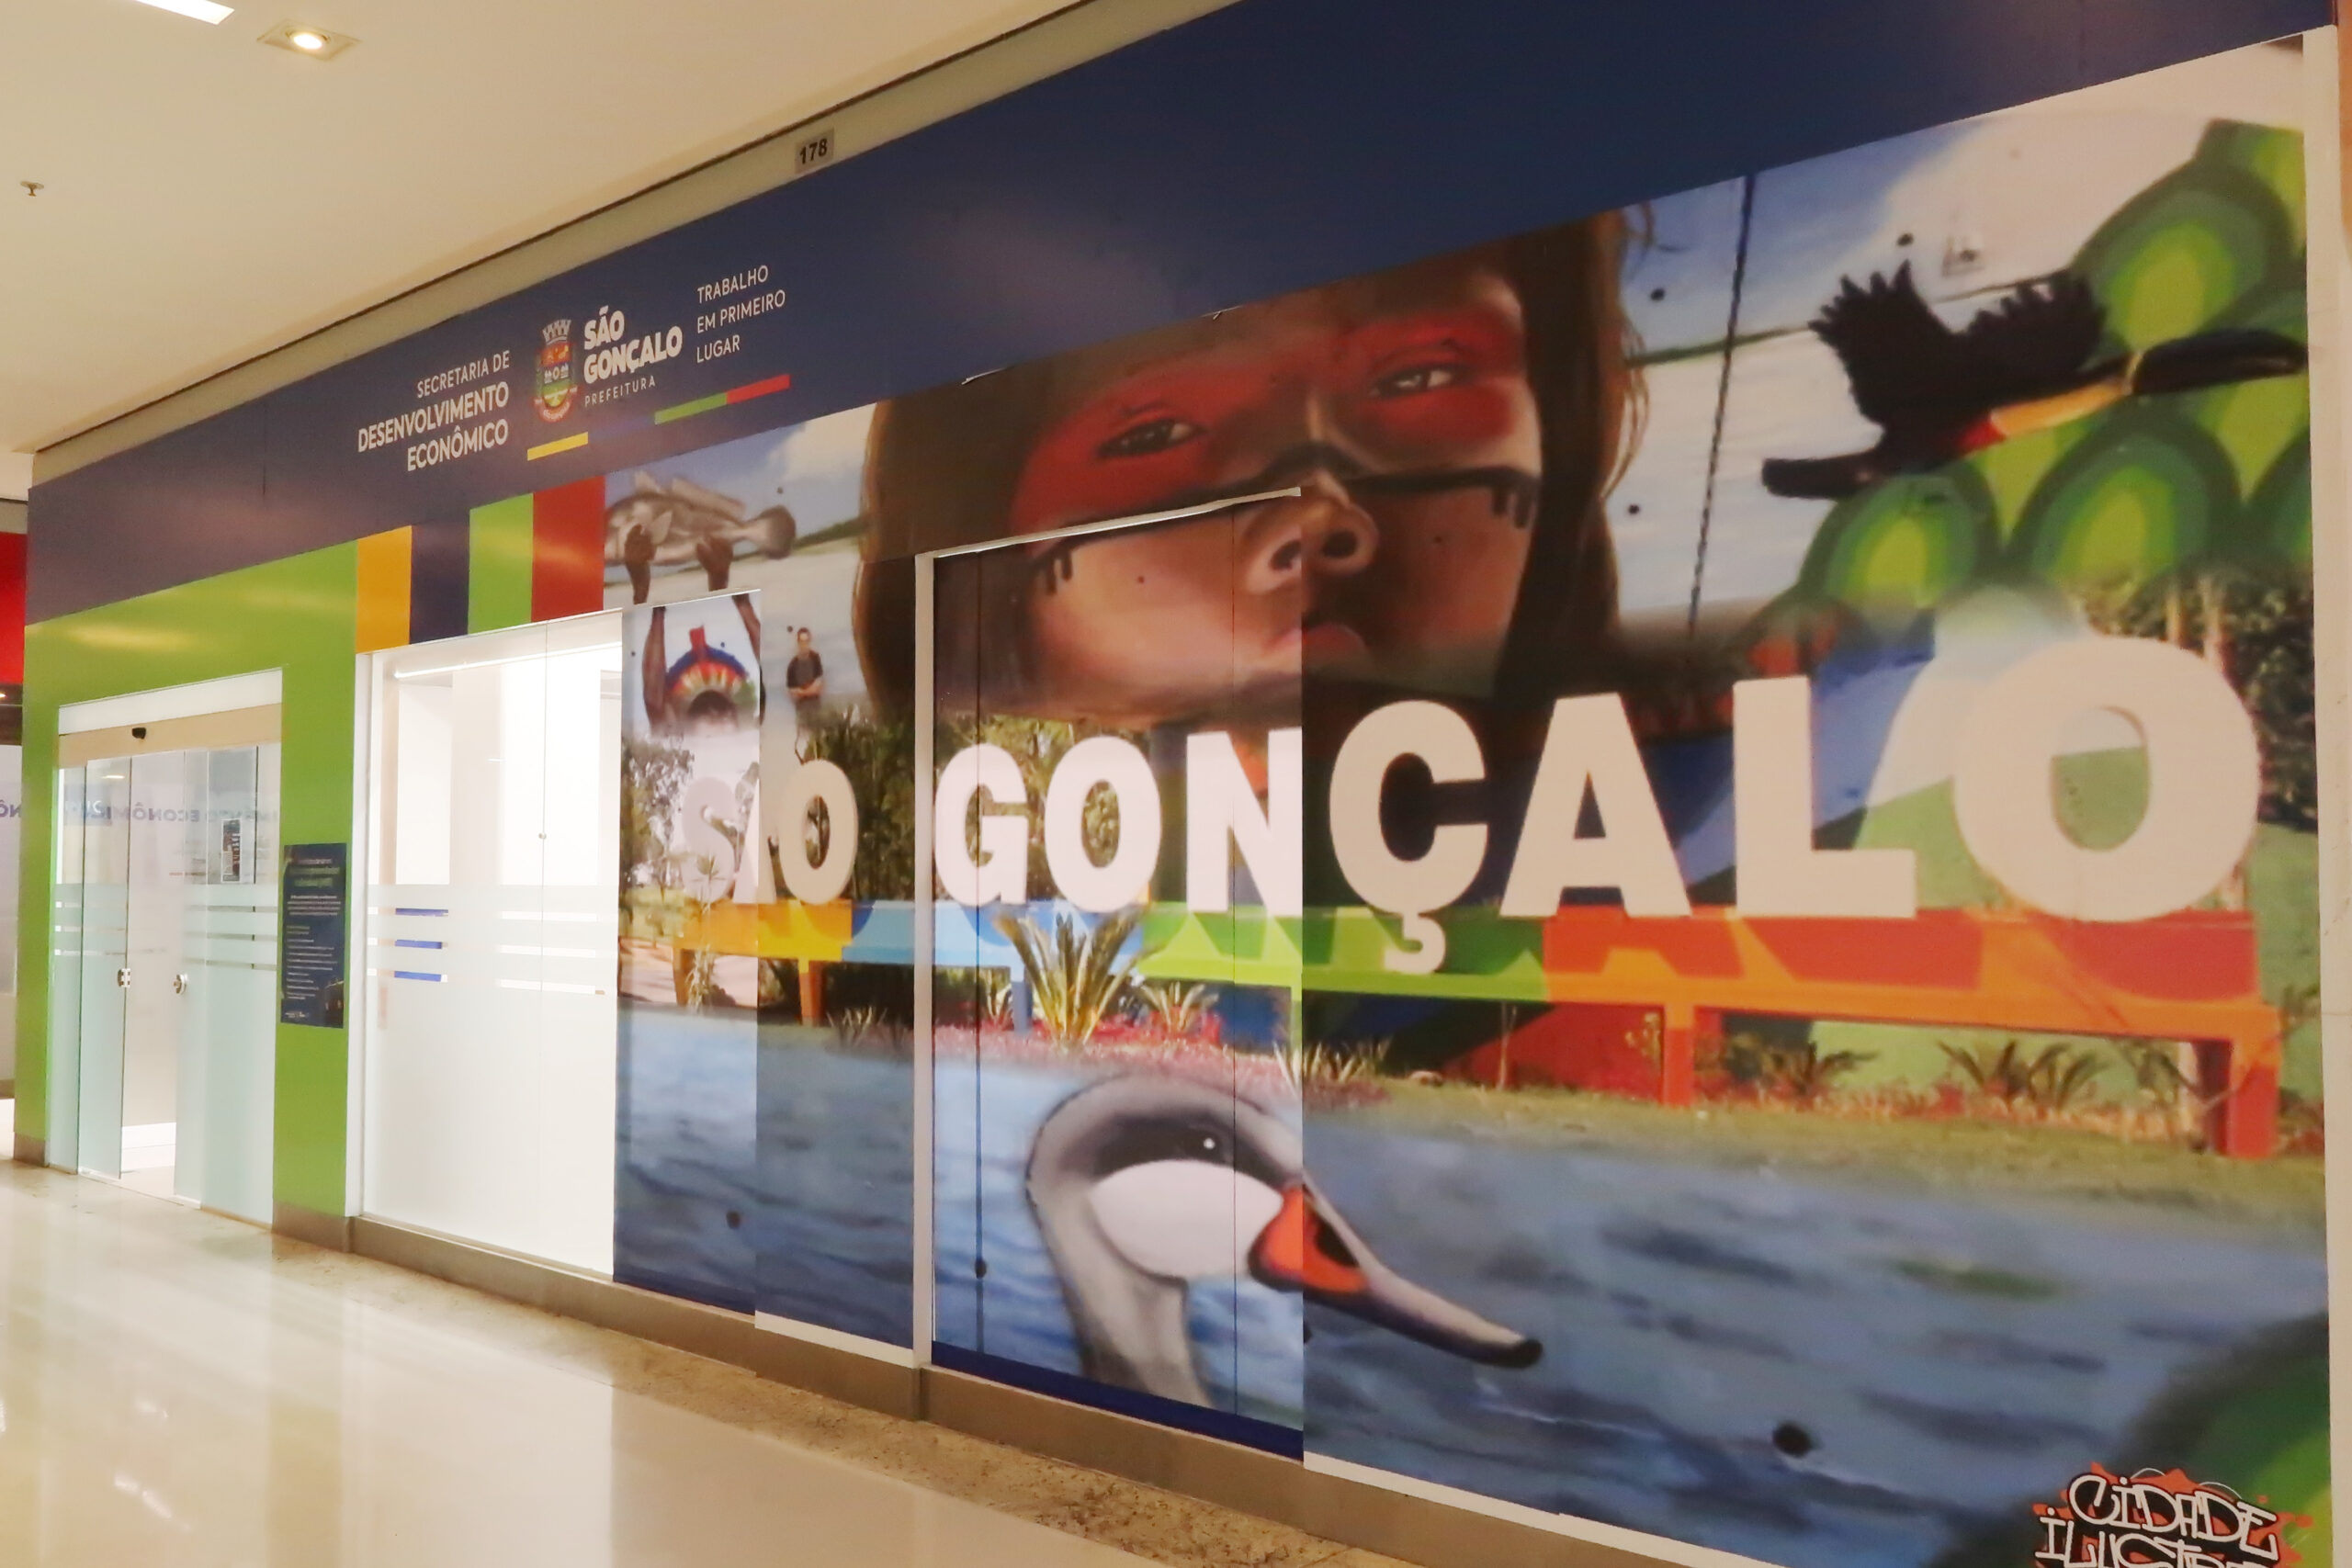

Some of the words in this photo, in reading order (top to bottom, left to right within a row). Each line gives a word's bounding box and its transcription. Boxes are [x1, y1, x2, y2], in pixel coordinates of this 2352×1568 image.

[799, 138, 828, 164] 178
[697, 265, 769, 304] TRABALHO
[584, 305, 625, 350] SÃO
[697, 312, 716, 334] EM
[720, 289, 786, 327] PRIMEIRO
[583, 325, 683, 384] GONÇALO
[696, 334, 741, 364] LUGAR
[417, 357, 489, 399] SECRETARIA
[492, 350, 510, 373] DE
[584, 375, 656, 408] PREFEITURA
[357, 381, 510, 453] DESENVOLVIMENTO
[407, 419, 509, 472] ECONÔMICO
[933, 635, 2261, 976] GONÇALO
[2068, 1474, 2278, 1561] CIDADE
